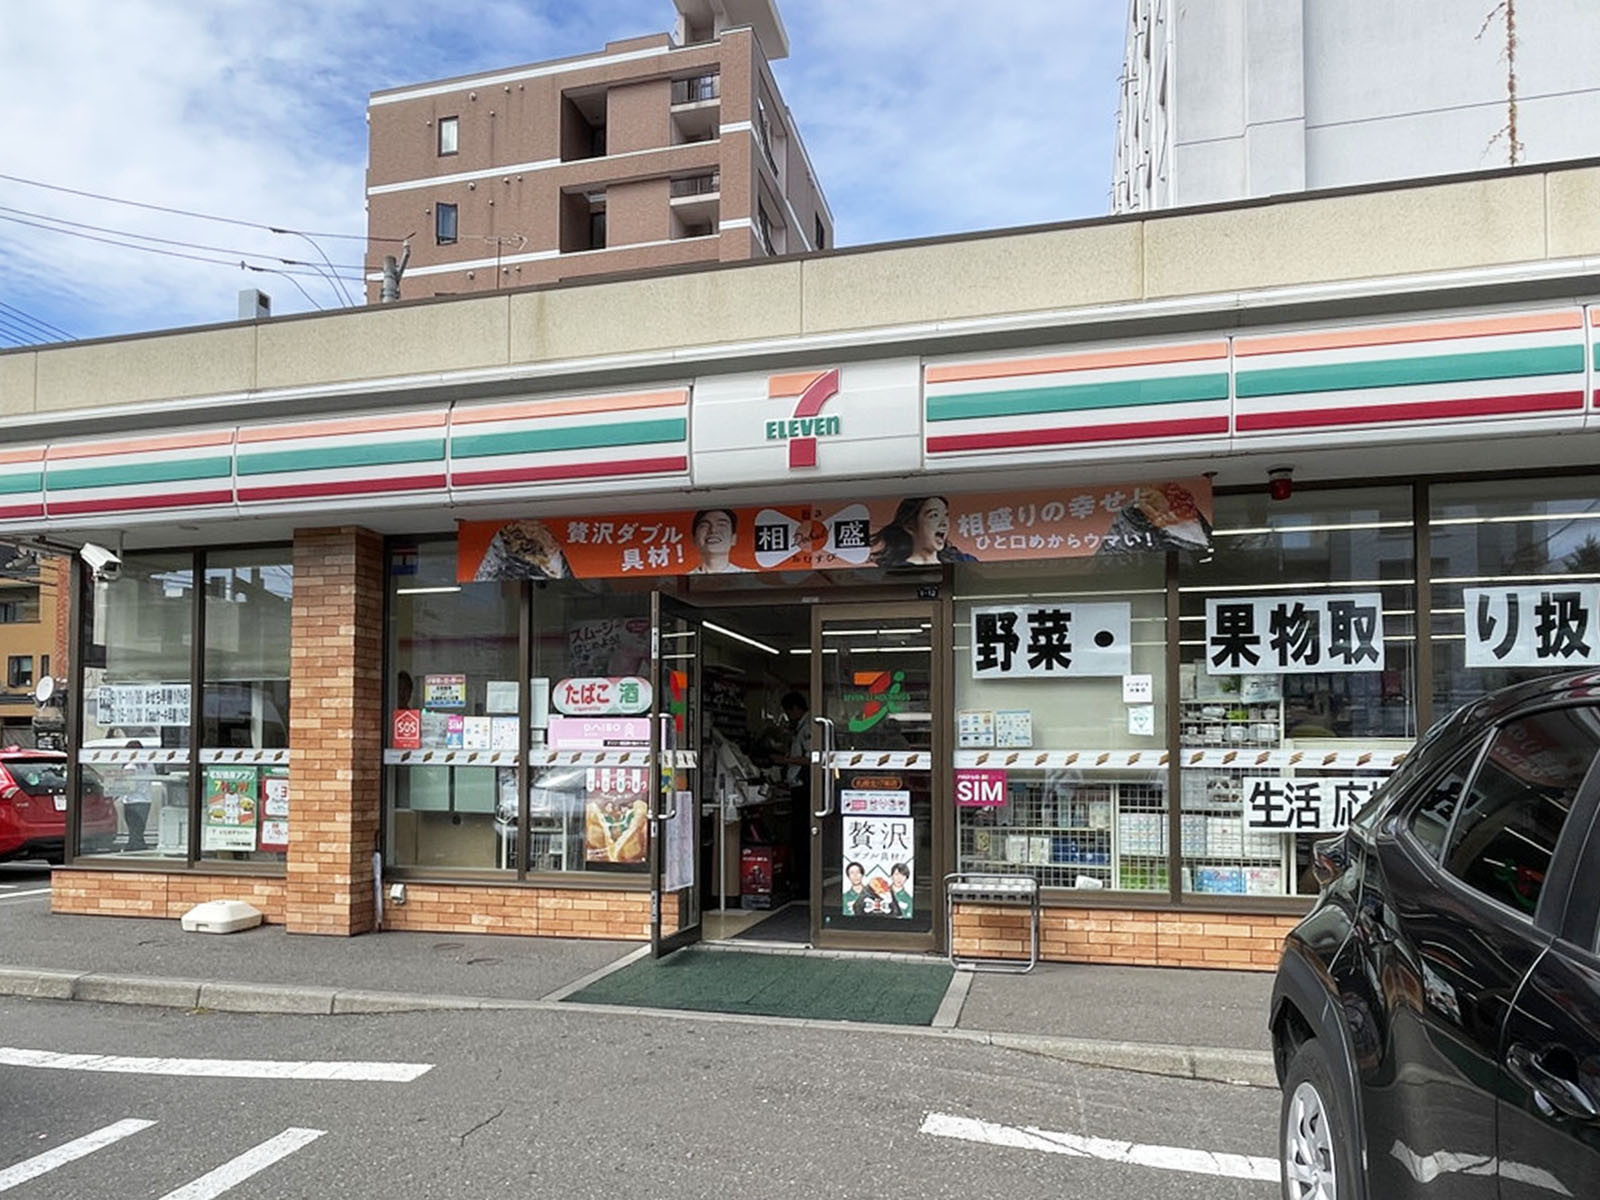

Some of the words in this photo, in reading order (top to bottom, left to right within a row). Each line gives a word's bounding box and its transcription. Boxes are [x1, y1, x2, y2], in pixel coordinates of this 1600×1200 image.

[769, 368, 839, 468] 7
[567, 521, 683, 545] 贅沢ダブル
[758, 526, 785, 551] 相
[838, 521, 866, 547] 盛
[975, 531, 1154, 550] ひと口めからウマい!
[621, 544, 685, 572] 具材!
[1210, 600, 1380, 668] 果物取
[1477, 591, 1591, 660] り扱
[565, 683, 610, 705] たばこ
[619, 682, 640, 704] 酒
[397, 722, 417, 734] SOS
[957, 781, 1003, 802] SIM
[1249, 781, 1383, 829] 生活応
[849, 821, 908, 851] 贅沢
